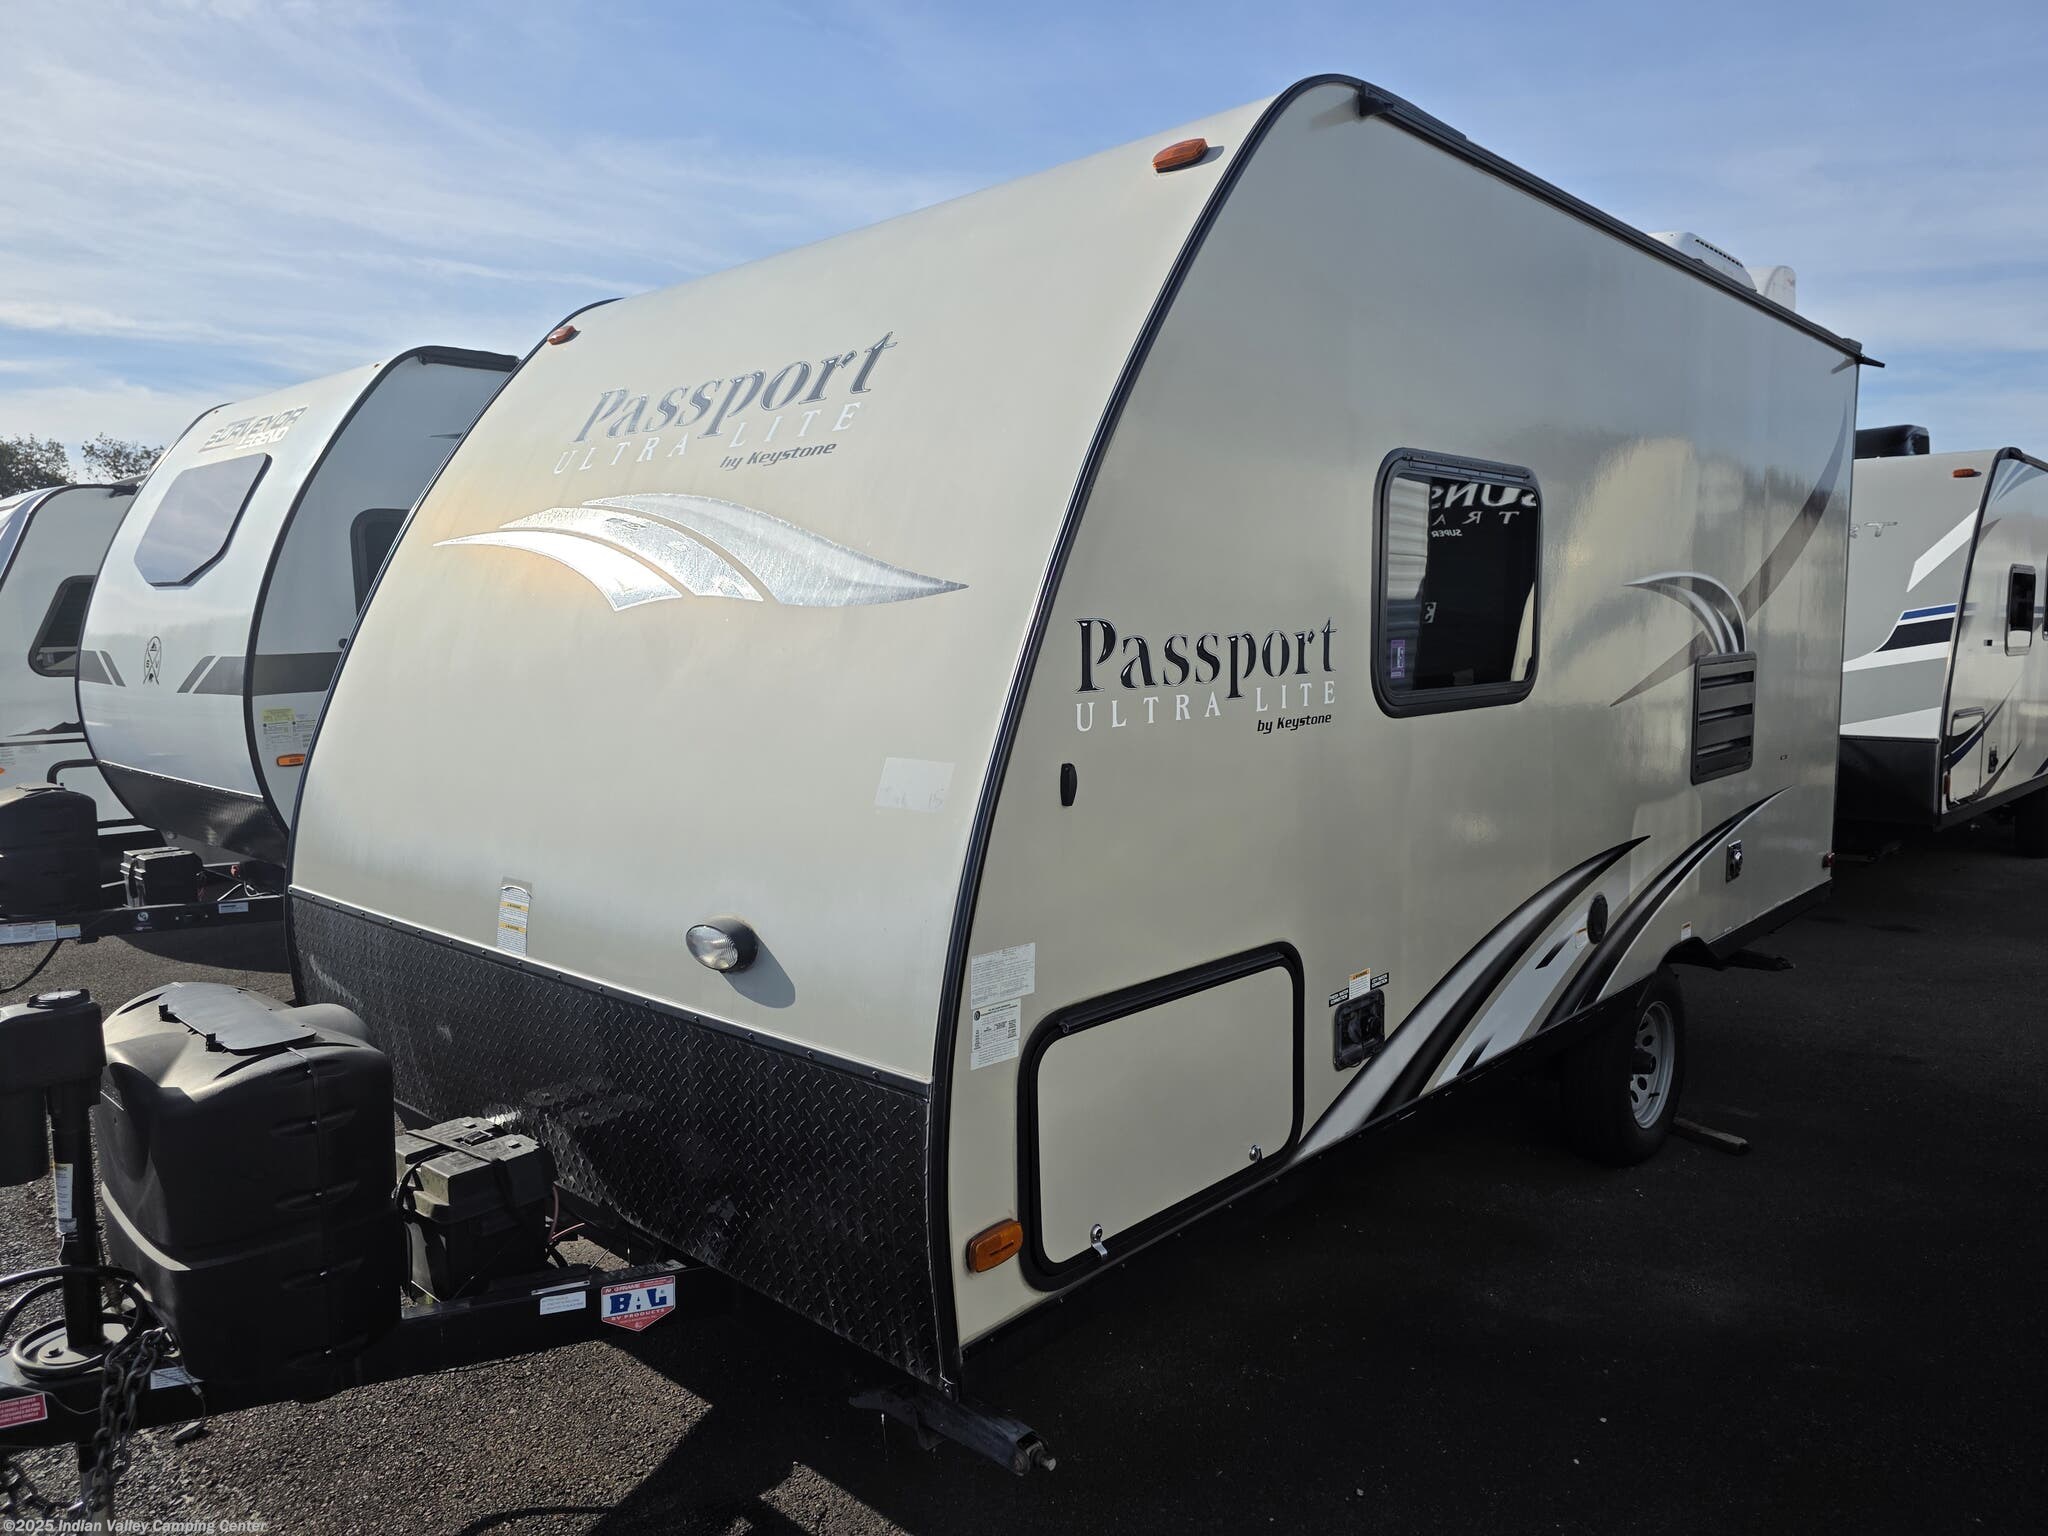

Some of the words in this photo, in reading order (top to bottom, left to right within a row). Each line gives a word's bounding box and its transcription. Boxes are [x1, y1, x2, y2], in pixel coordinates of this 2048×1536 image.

[569, 330, 898, 444] Passport
[203, 405, 309, 446] SURVEYOR
[553, 431, 689, 475] ULTRA
[729, 401, 861, 449] LITE
[719, 455, 743, 472] by
[747, 443, 837, 468] Keystone
[1074, 617, 1337, 699] Passport
[1076, 691, 1221, 732] ULTRA
[1256, 680, 1336, 713] LITE
[1257, 719, 1273, 735] by
[1277, 713, 1332, 732] Keystone
[610, 1288, 667, 1315] BAL
[624, 1308, 665, 1319] PRODUCTS
